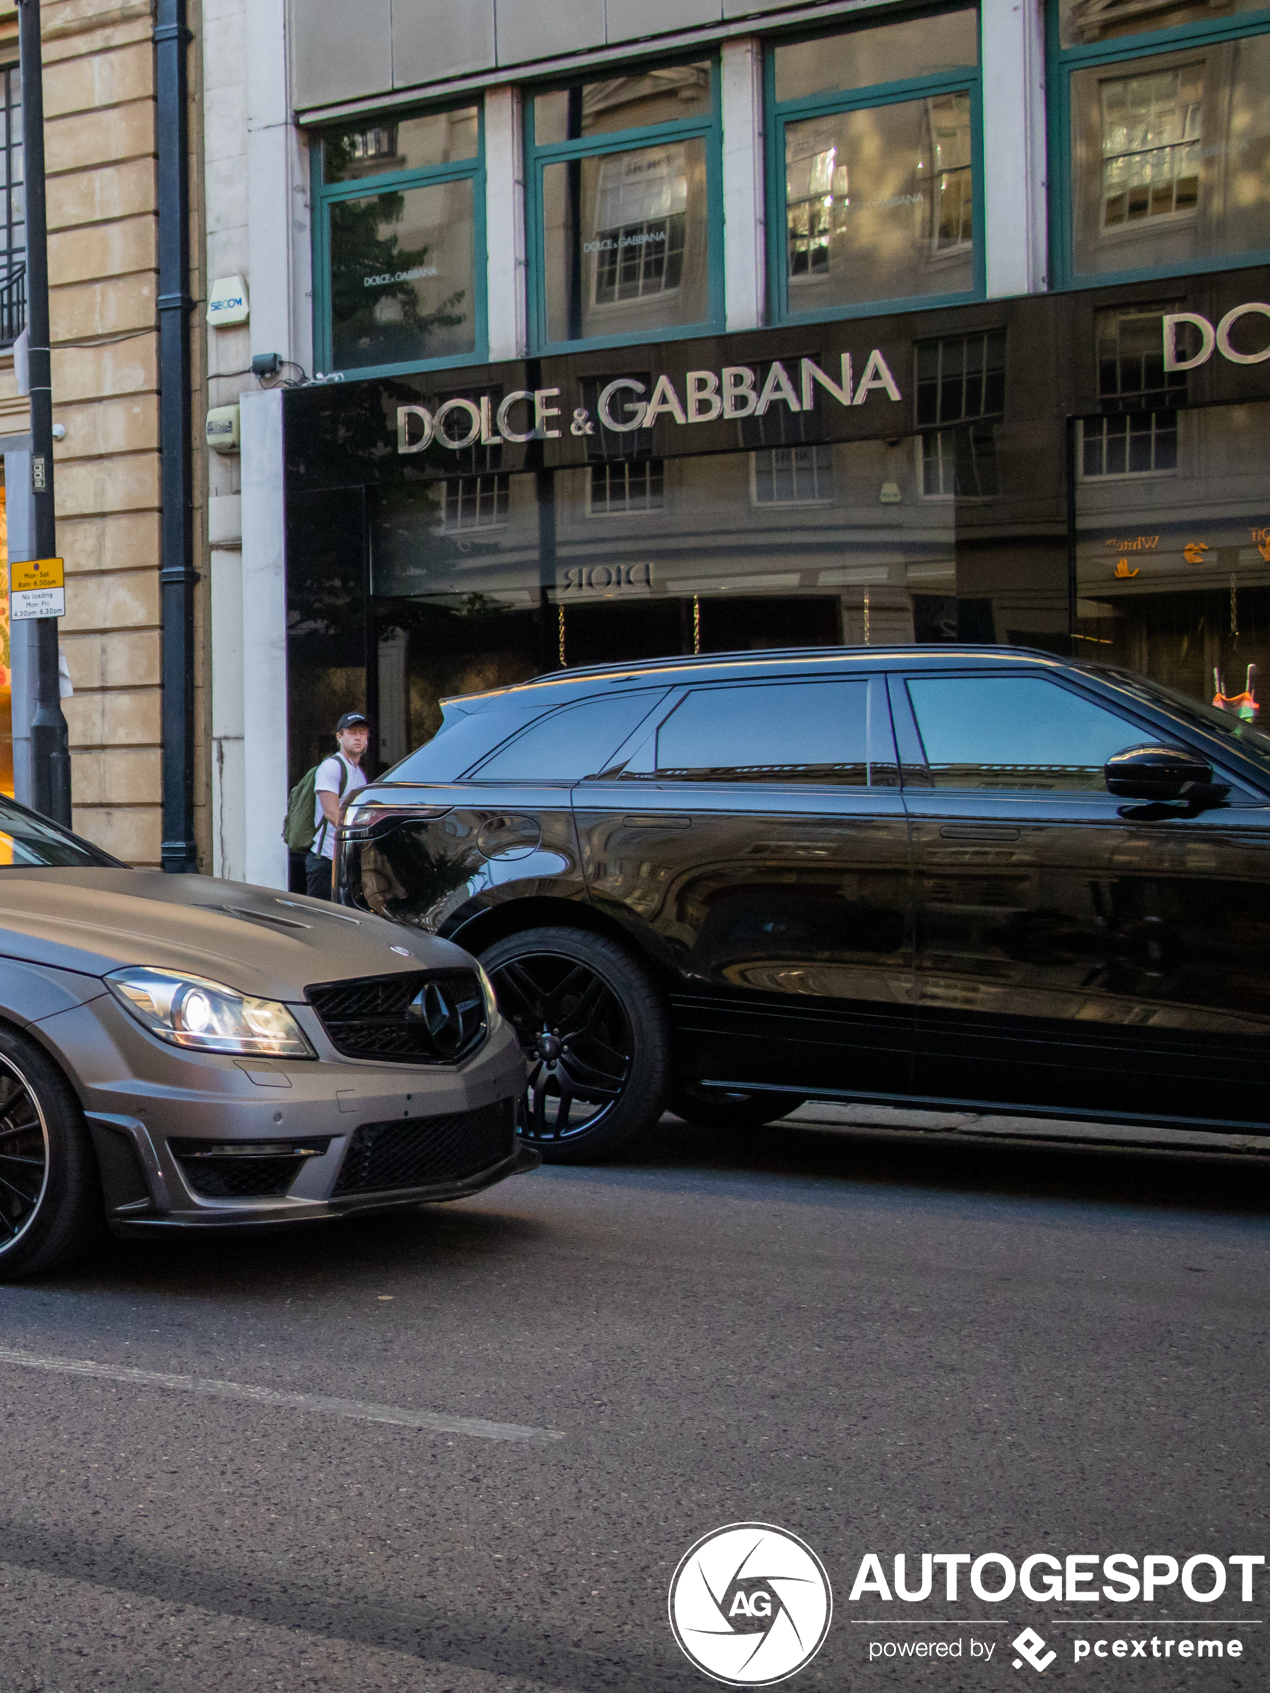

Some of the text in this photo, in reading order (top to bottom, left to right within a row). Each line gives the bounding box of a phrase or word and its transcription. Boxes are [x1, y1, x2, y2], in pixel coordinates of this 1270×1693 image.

[583, 239, 612, 253] DOLCE
[619, 231, 667, 248] GABBANA
[364, 273, 391, 287] DOLCE
[210, 297, 243, 311] SECOM
[397, 349, 902, 455] DOLCE & GABBANA
